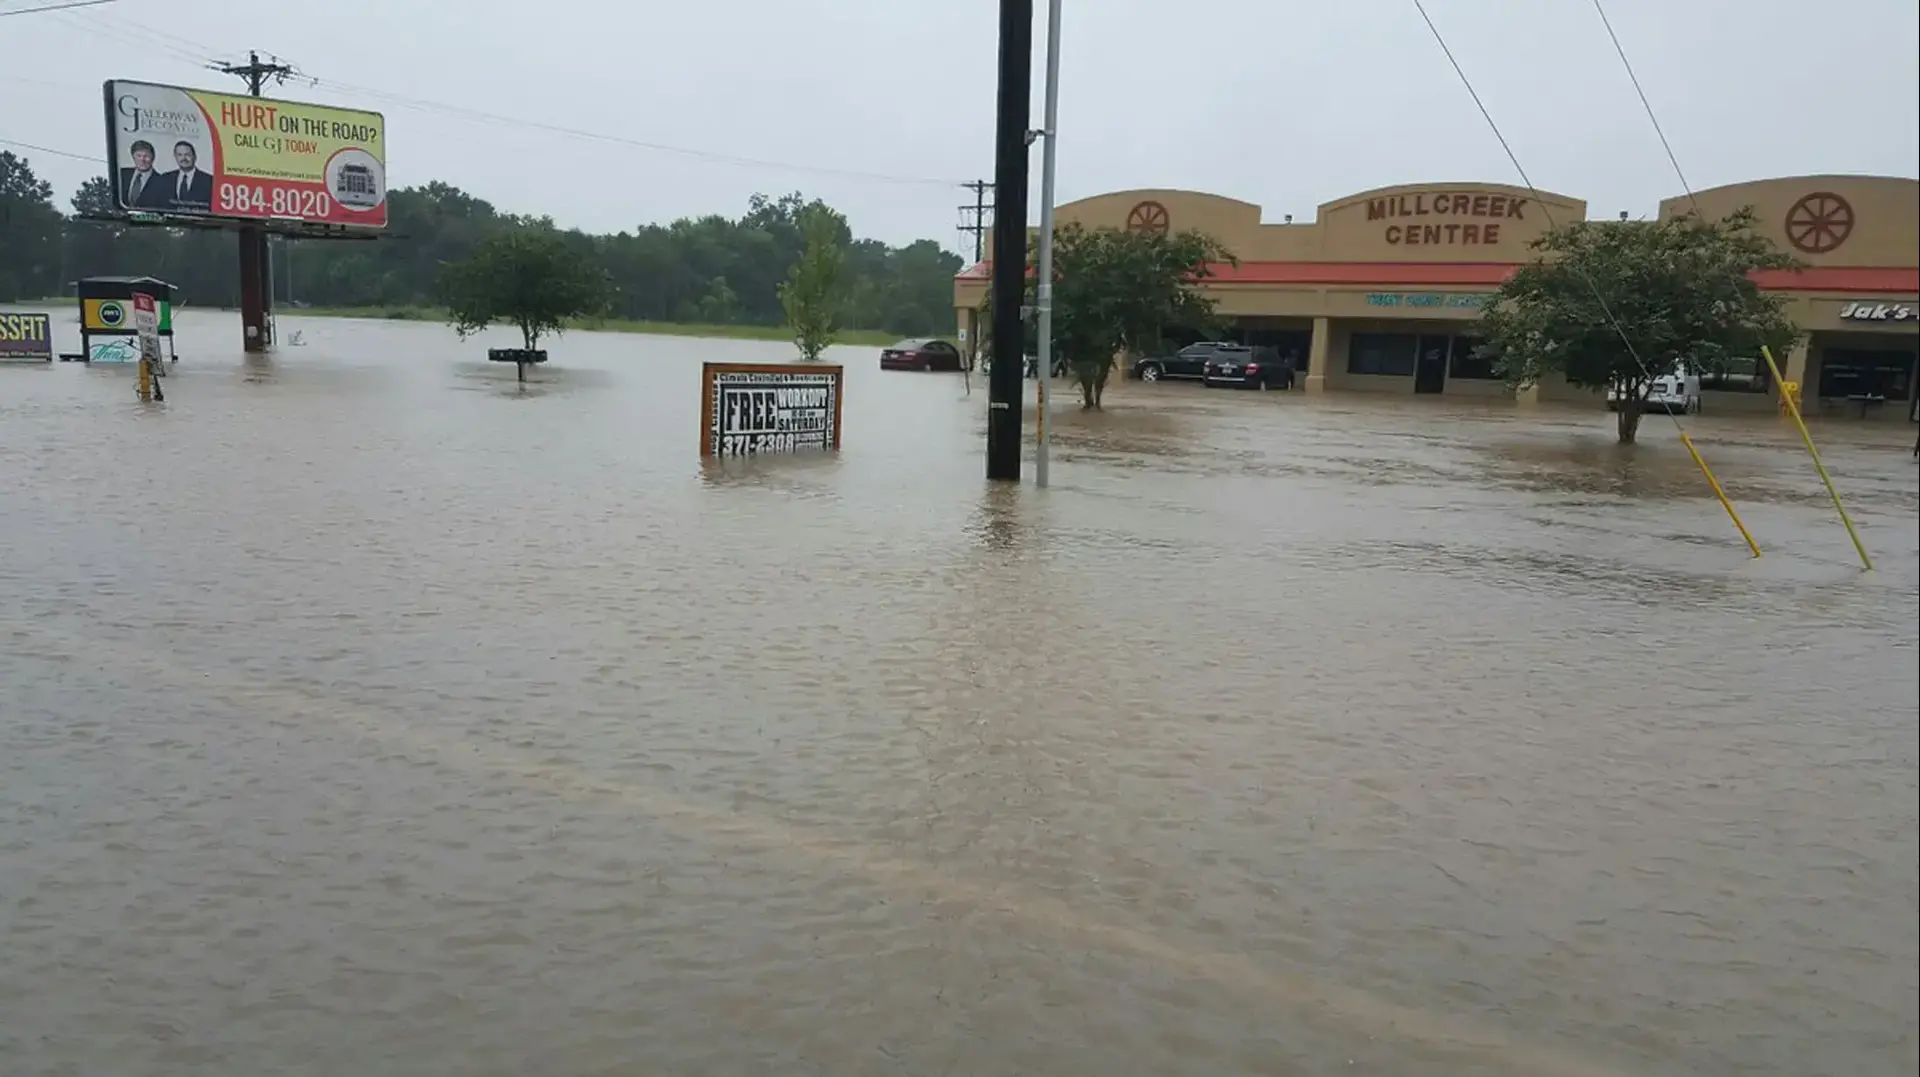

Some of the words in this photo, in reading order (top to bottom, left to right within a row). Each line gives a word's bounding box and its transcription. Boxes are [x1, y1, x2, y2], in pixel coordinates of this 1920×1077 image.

[221, 102, 277, 129] HURT
[279, 116, 298, 133] ON
[305, 119, 328, 137] THE
[332, 122, 377, 143] ROAD?
[234, 134, 259, 149] CALL
[1367, 194, 1528, 221] MILLCREEK
[1385, 223, 1500, 245] CENTRE
[1840, 302, 1911, 320] Jak's
[778, 388, 827, 408] WORKOUT
[726, 392, 776, 431] FREE
[779, 417, 825, 431] SATURDAY
